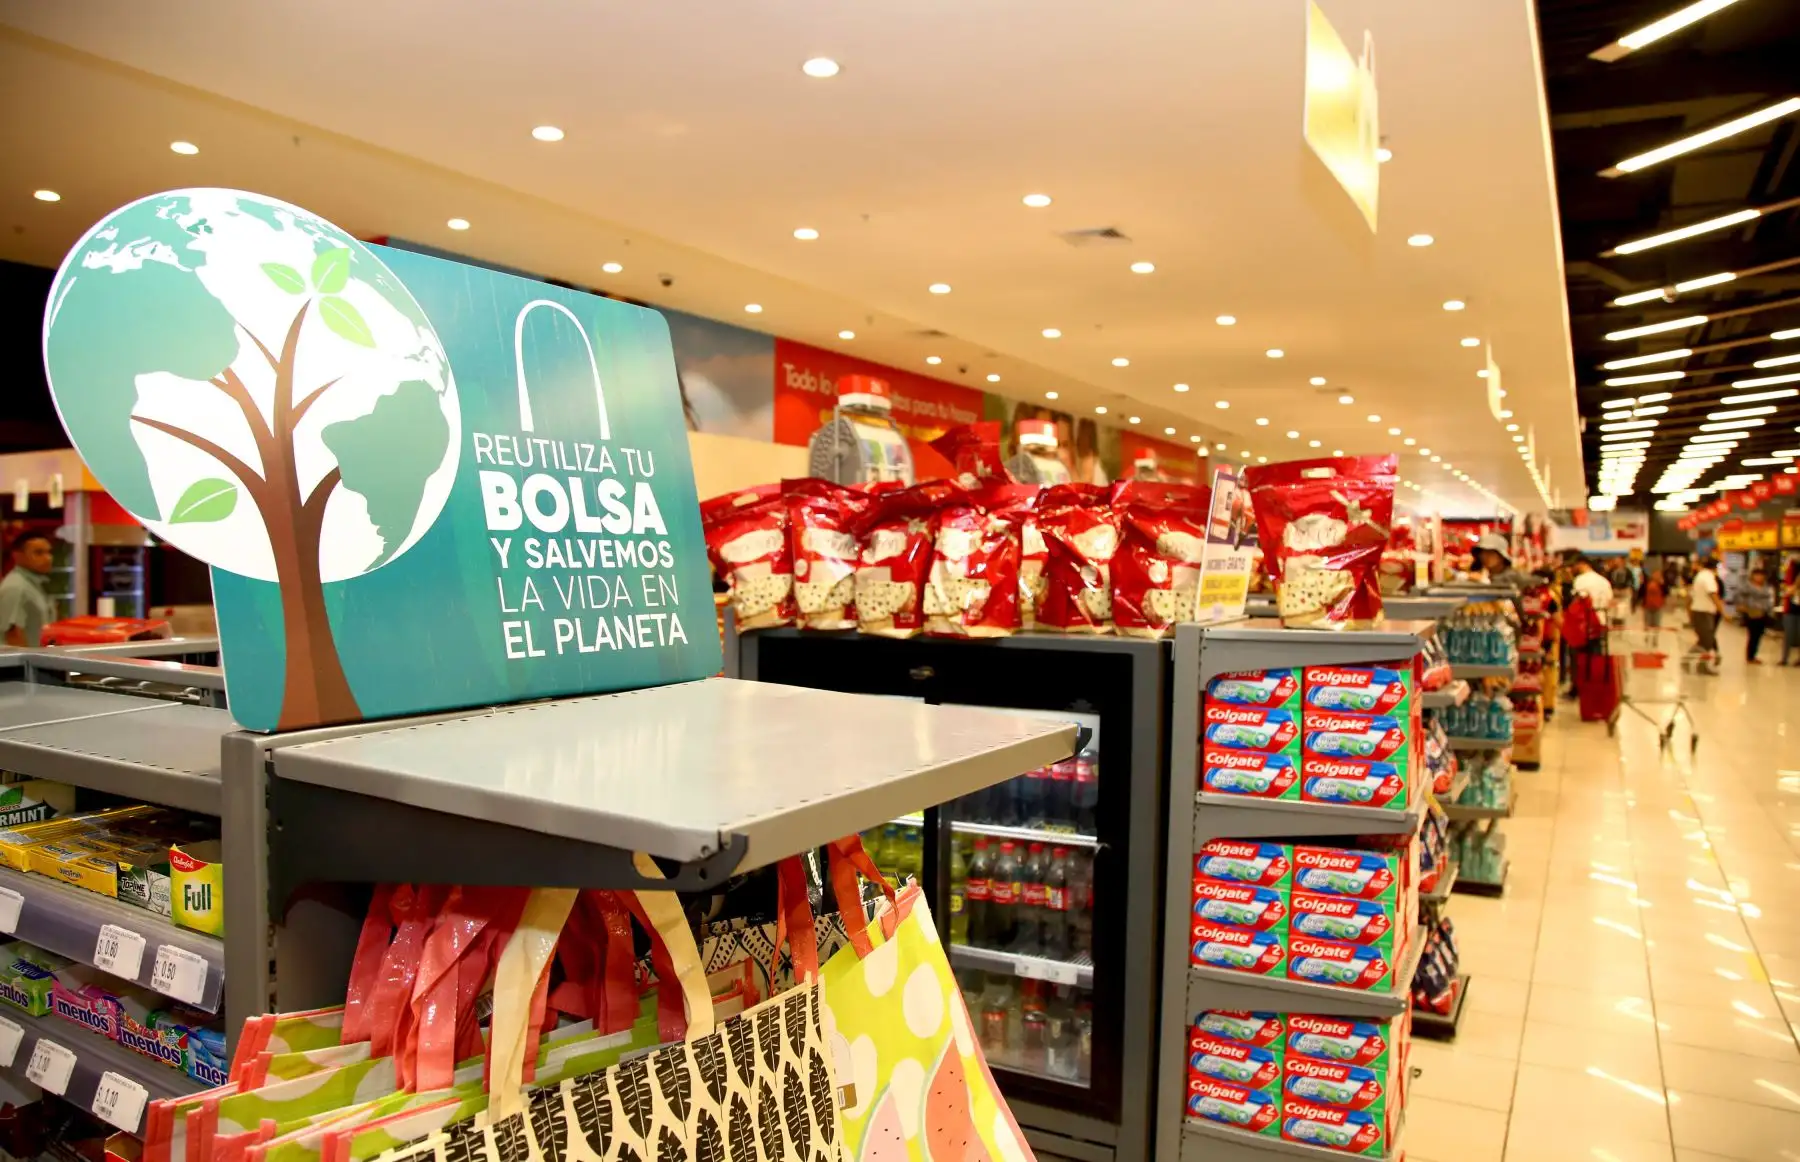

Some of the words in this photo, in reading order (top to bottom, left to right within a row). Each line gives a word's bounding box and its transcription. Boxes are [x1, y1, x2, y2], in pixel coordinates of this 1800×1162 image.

[473, 432, 617, 475] REUTILIZA
[620, 447, 655, 477] TU
[479, 470, 668, 535] BOLSA
[490, 537, 512, 569] Y
[524, 537, 674, 569] SALVEMOS
[497, 576, 545, 613] LA
[553, 575, 633, 610] VIDA
[641, 574, 679, 607] EN
[503, 620, 546, 659] EL
[554, 612, 688, 655] PLANETA
[1285, 677, 1294, 688] 2
[1307, 669, 1368, 685] Colgate
[1393, 682, 1402, 694] 2
[1207, 707, 1262, 723] Colgate
[1306, 715, 1368, 731] Colgate
[1285, 722, 1294, 732] 2
[1391, 728, 1401, 740] 2
[1205, 752, 1261, 768] Colgate
[1284, 767, 1294, 777] 2
[1304, 760, 1366, 777] Colgate
[1390, 775, 1399, 787] 2
[1201, 843, 1254, 857] olgate
[1277, 857, 1286, 868] 2
[1296, 852, 1356, 868] Colgate
[1380, 869, 1389, 880] 2
[184, 883, 211, 911] Full
[1195, 883, 1252, 900] Colgate
[1274, 901, 1282, 912] 2
[1293, 898, 1354, 914] Colgate
[1377, 914, 1386, 925] 2
[1194, 925, 1251, 943] Colgate
[1272, 945, 1281, 956] 2
[1291, 941, 1352, 958] Colgate
[1375, 959, 1384, 970] 2
[57, 999, 109, 1032] mentos
[1271, 1019, 1280, 1030] 2
[1289, 1016, 1348, 1034] Colgate
[121, 1028, 181, 1064] mentos
[1192, 1038, 1246, 1058] Colgate
[1372, 1036, 1381, 1047] 2
[1267, 1062, 1276, 1073] 2
[1286, 1060, 1345, 1078] Colgate
[1190, 1080, 1245, 1100] Colgate
[1369, 1081, 1378, 1092] 2
[1266, 1104, 1275, 1115] 2
[1284, 1102, 1343, 1122] Colgate
[1367, 1125, 1376, 1136] 2
